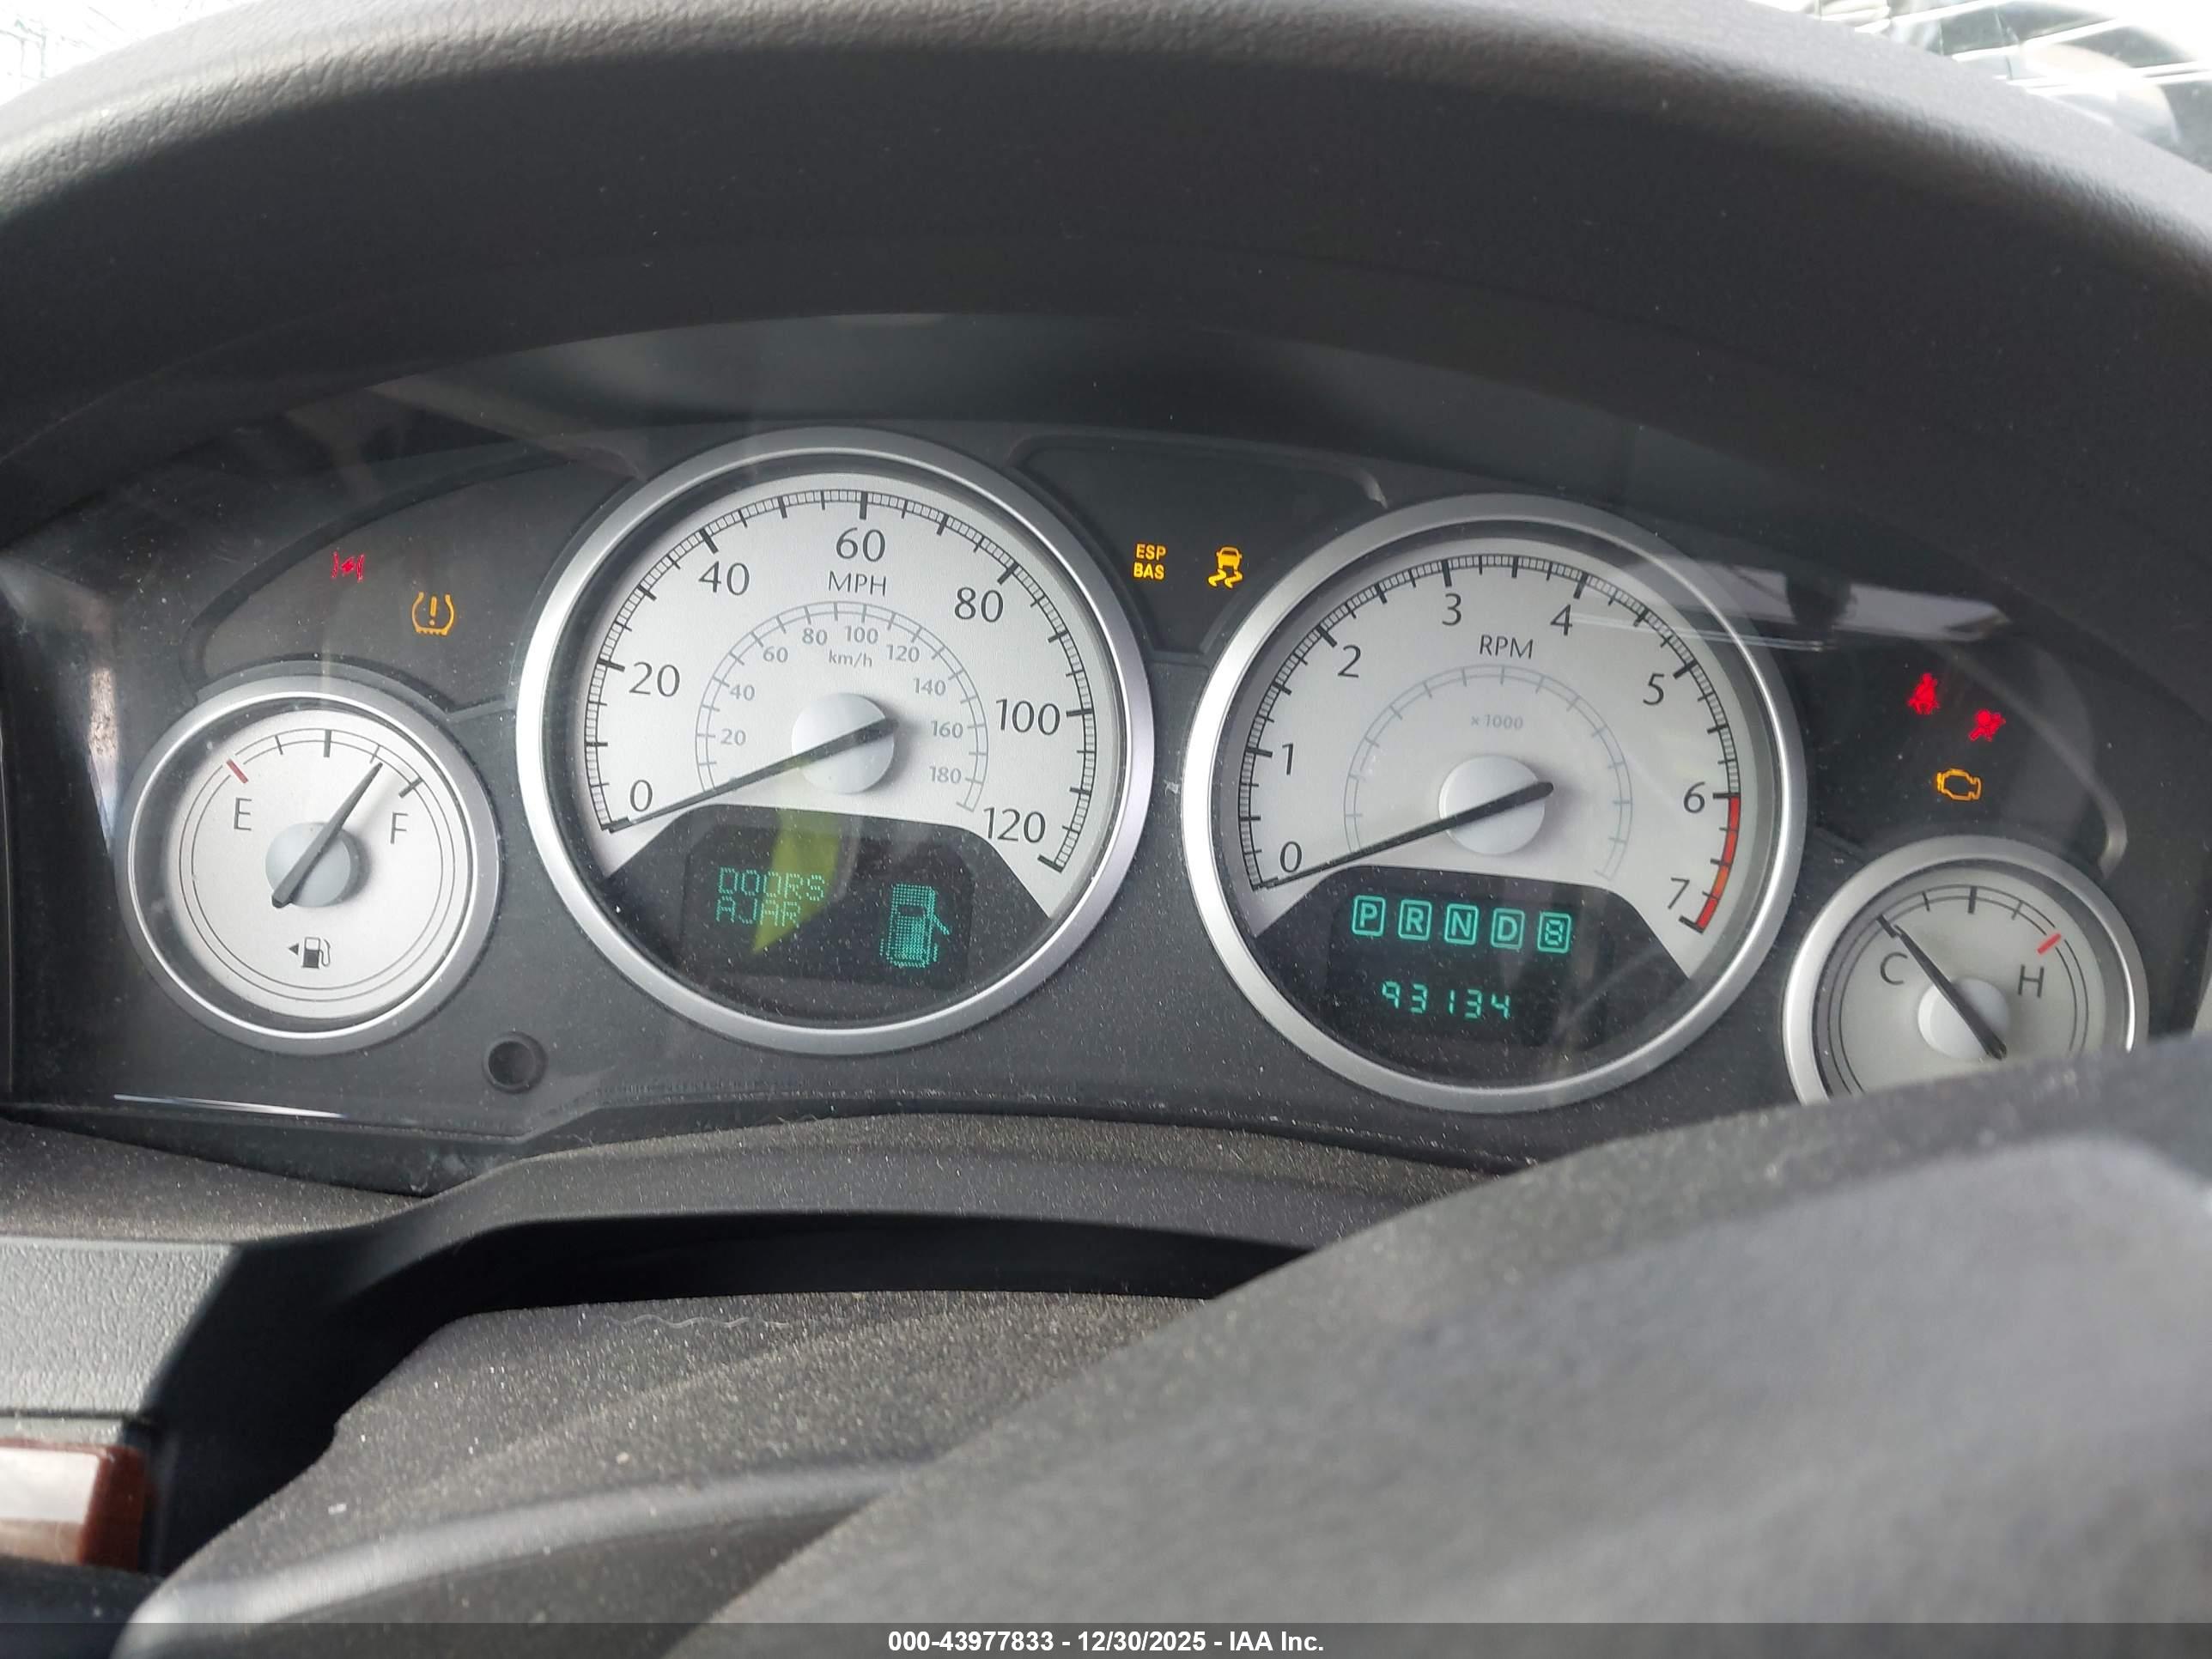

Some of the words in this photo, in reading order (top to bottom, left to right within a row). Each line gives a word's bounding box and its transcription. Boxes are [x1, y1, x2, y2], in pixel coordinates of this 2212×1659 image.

[836, 527, 886, 562] 60
[1136, 543, 1167, 561] ESP
[699, 561, 750, 596] 40
[827, 571, 887, 598] MPH
[1133, 562, 1164, 580] BAS
[955, 586, 1004, 623] 80
[1442, 593, 1462, 626] 3
[1551, 604, 1574, 635] 4
[802, 626, 827, 647] 80
[844, 626, 878, 646] 100
[1479, 634, 1534, 659] RPM
[763, 646, 789, 665] 60
[828, 647, 873, 669] km/h
[886, 644, 921, 664] 120
[1337, 646, 1363, 678] 2
[629, 661, 681, 697] 20
[729, 684, 756, 702] 40
[913, 677, 946, 696] 140
[1643, 672, 1666, 706] 5
[931, 720, 963, 739] 160
[996, 698, 1061, 736] 100
[720, 728, 747, 747] 20
[1281, 743, 1296, 775] 1
[928, 765, 962, 786] 180
[629, 779, 653, 812] 0
[1683, 781, 1706, 813] 6
[234, 797, 252, 830] E
[390, 811, 409, 844] F
[983, 807, 1048, 843] 120
[1279, 841, 1303, 873] 0
[718, 866, 825, 902] DOORS
[1668, 878, 1692, 910] 7
[715, 896, 800, 928] AJAR
[1359, 902, 1378, 927] P
[1406, 907, 1425, 933] R
[1451, 911, 1472, 938] N
[1497, 915, 1518, 942] D
[1880, 951, 1908, 985] C
[2017, 964, 2045, 998] H
[1382, 981, 1511, 1020] 93134
